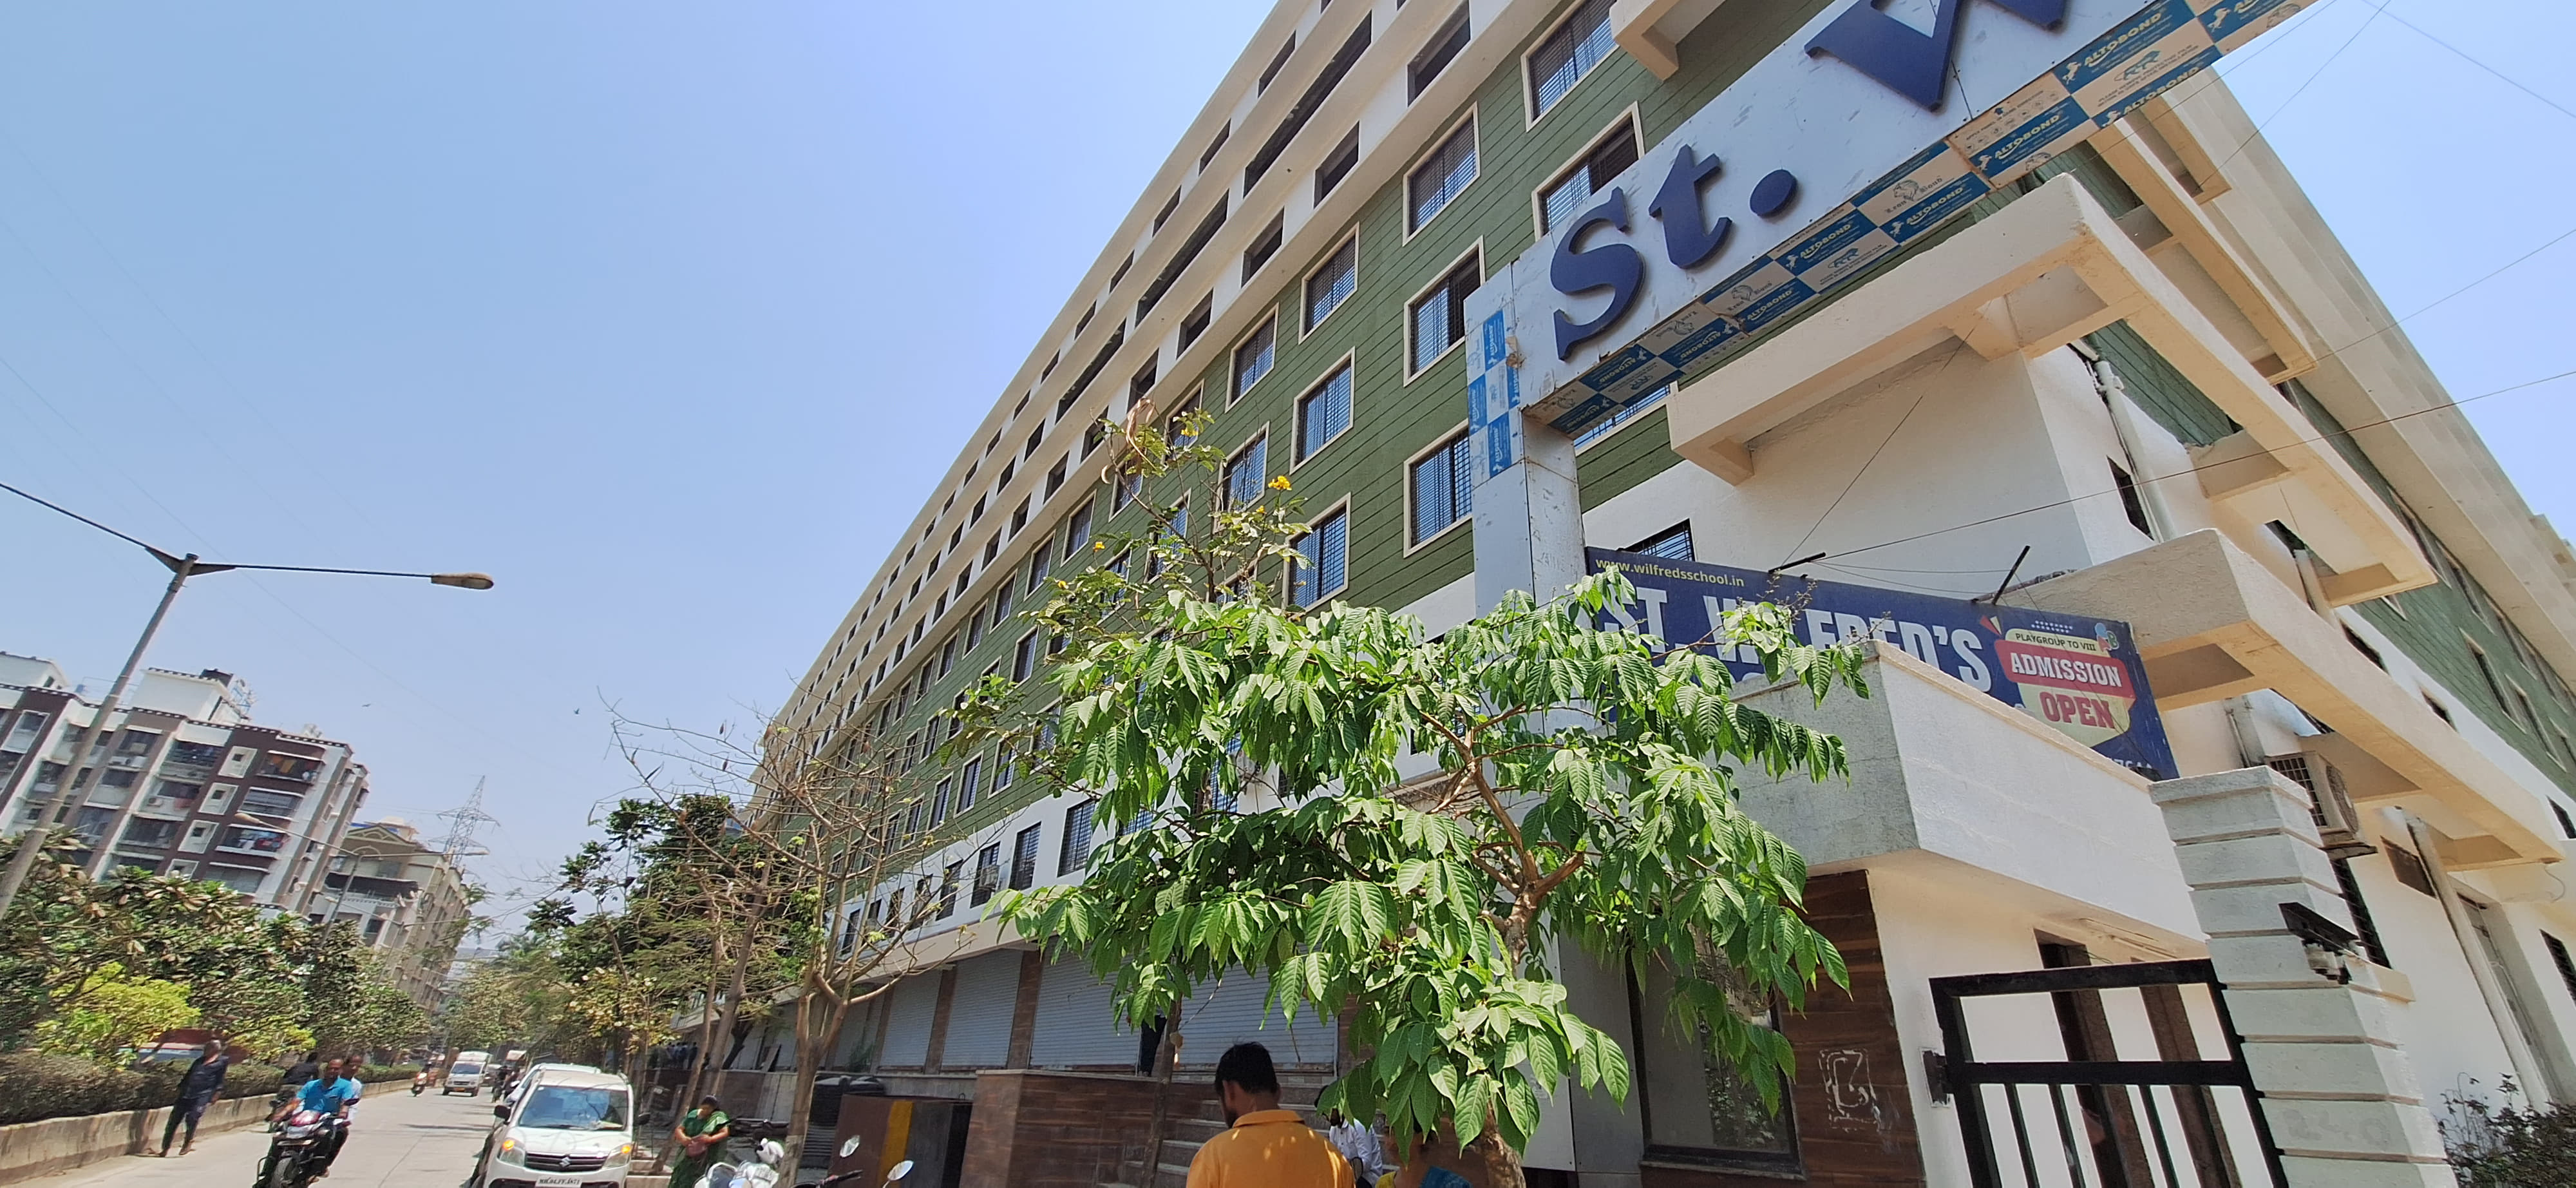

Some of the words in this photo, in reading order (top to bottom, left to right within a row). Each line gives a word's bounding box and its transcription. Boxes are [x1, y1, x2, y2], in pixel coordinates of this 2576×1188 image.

[2084, 12, 2162, 67] ALTOBOND
[1994, 115, 2060, 160] ALTOBOND
[1906, 187, 1964, 225] ALTOBOND
[1550, 144, 1797, 361] St.
[1800, 224, 1852, 259] ALTOBOND
[1747, 290, 1792, 320] ALTOBOND
[1681, 330, 1721, 359] ALTOBOND
[1595, 557, 1745, 588] www.wilfredsschool.in
[2015, 633, 2065, 647] PLAYGROUP
[2067, 640, 2079, 649] TO
[2080, 642, 2096, 651] VIII
[2010, 652, 2123, 688] ADMISSION
[2039, 691, 2116, 729] OPEN
